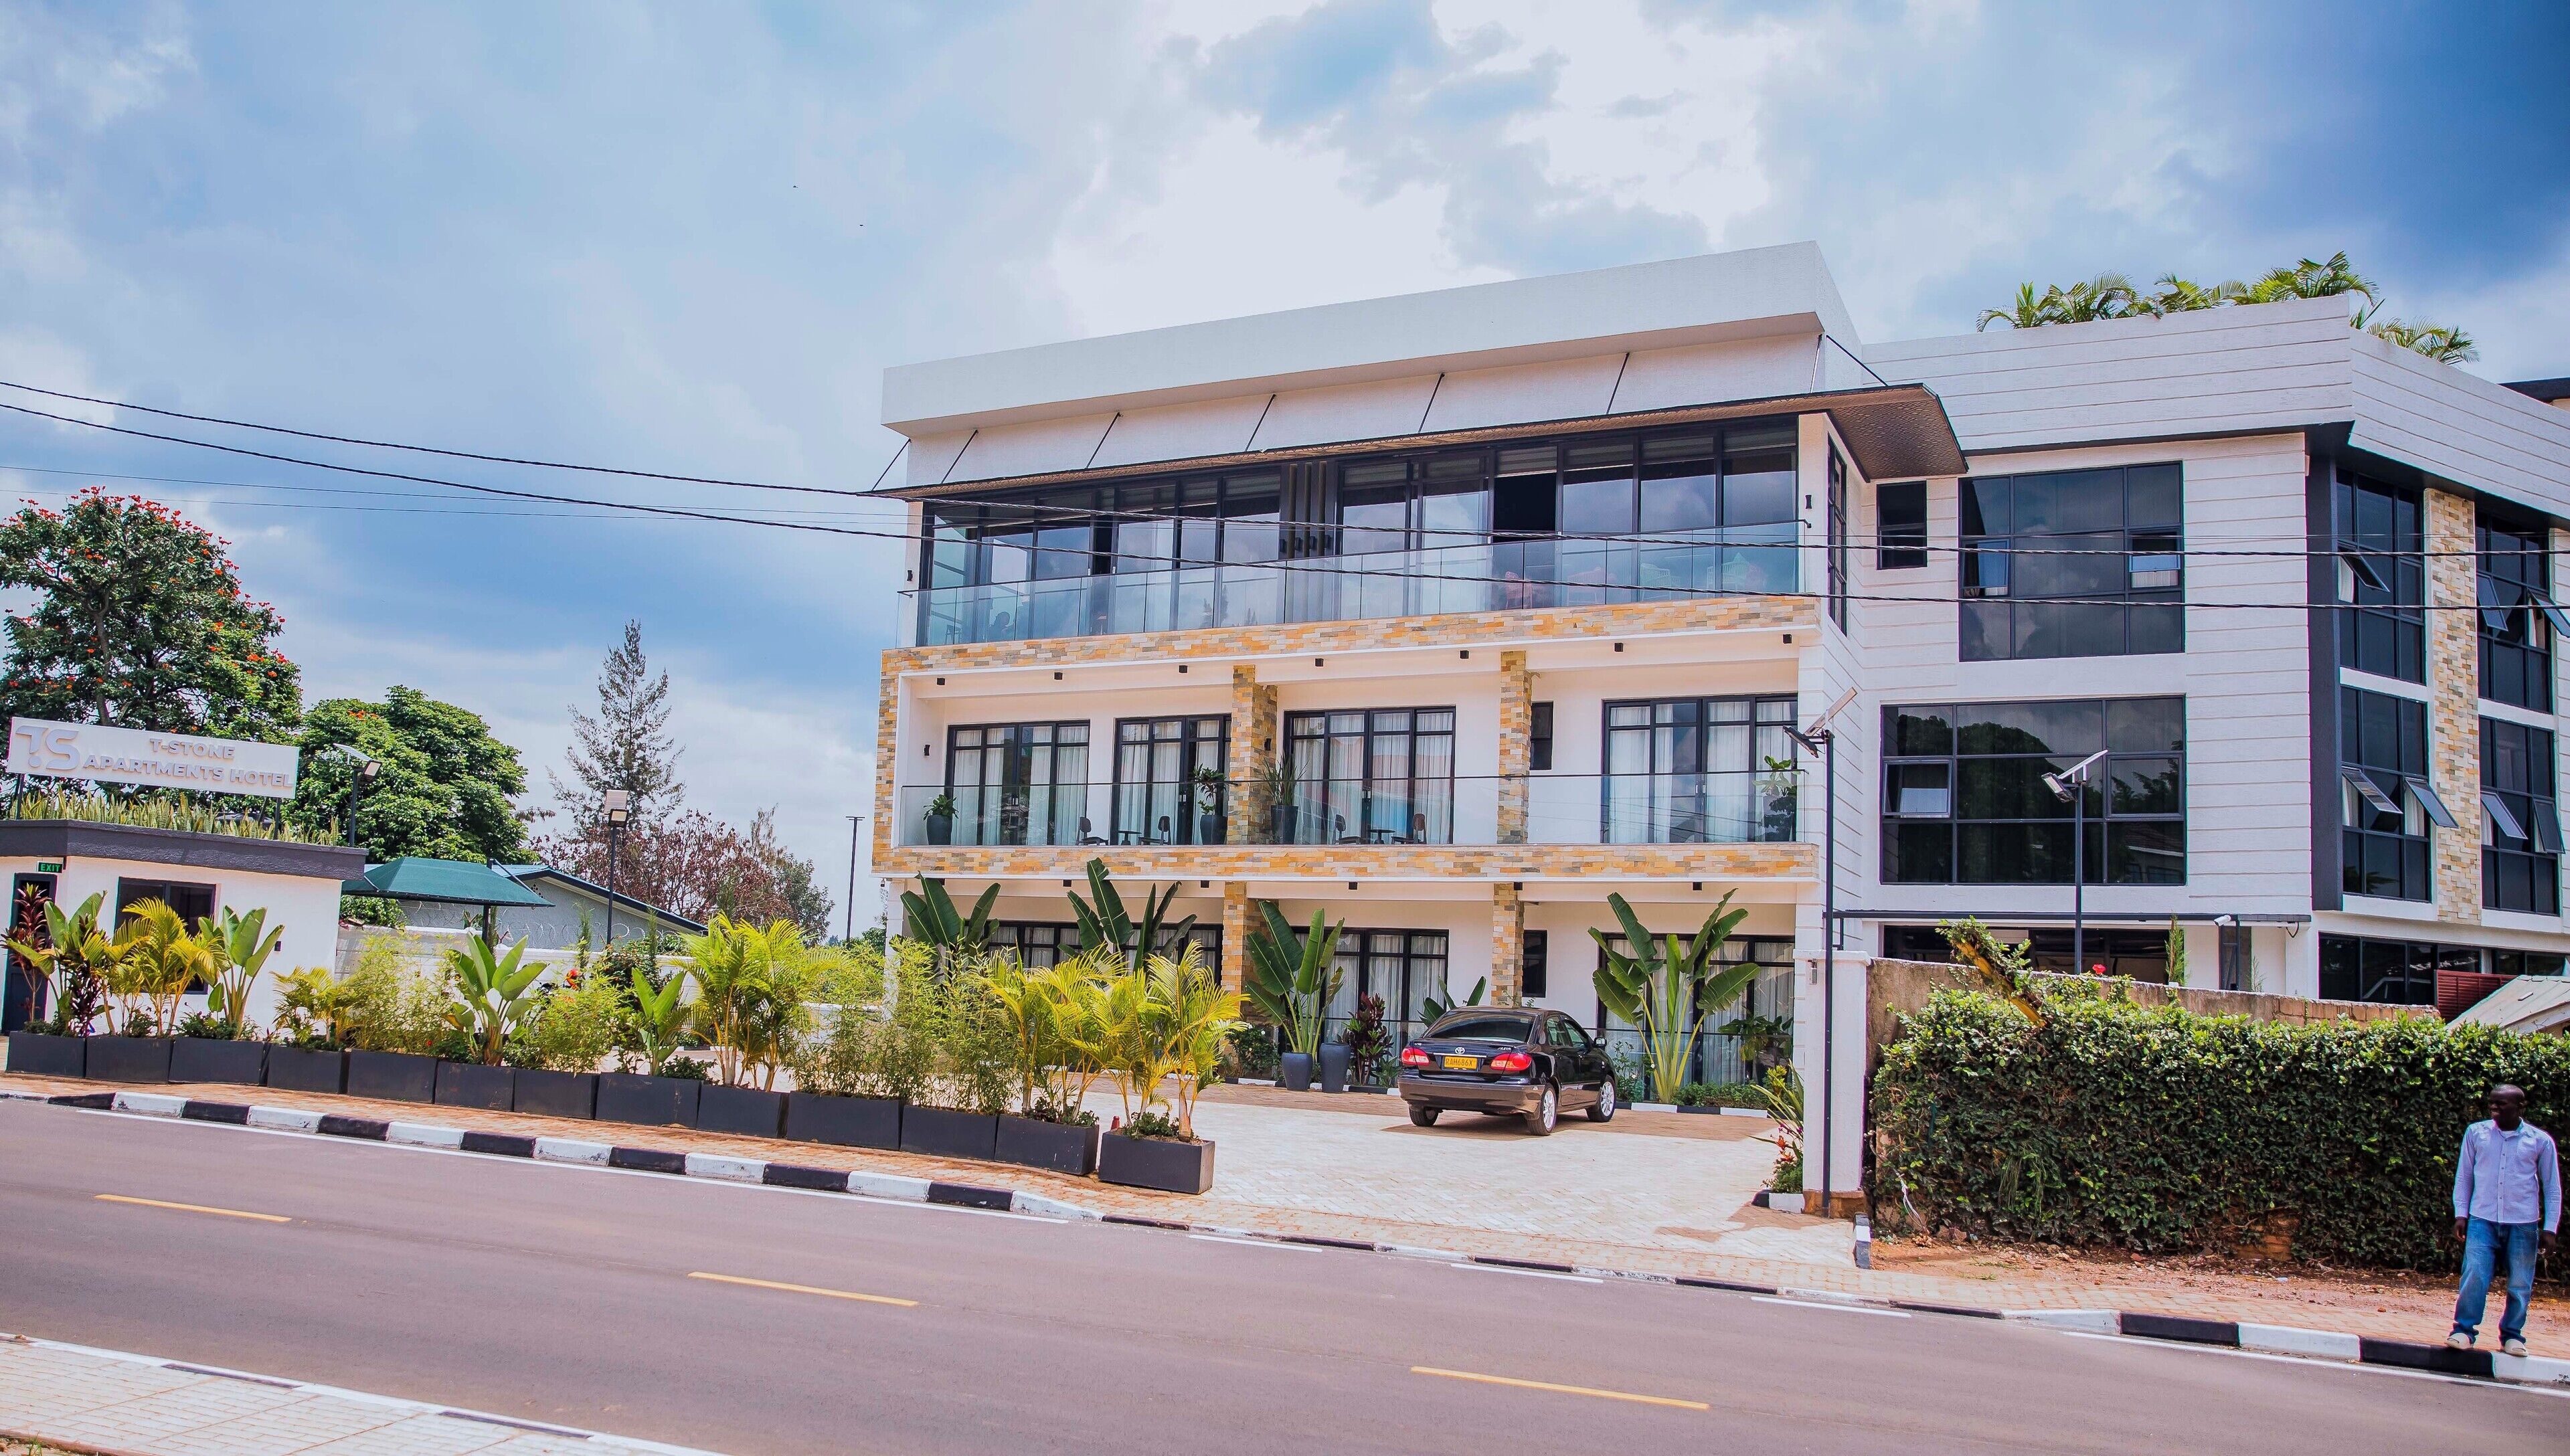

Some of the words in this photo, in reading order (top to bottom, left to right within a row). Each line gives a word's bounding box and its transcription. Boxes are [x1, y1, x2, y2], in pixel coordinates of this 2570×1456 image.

[149, 738, 236, 760] T-STONE
[82, 754, 224, 782] APARTMENTS
[230, 768, 294, 788] HOTEL
[40, 863, 60, 872] EXIT
